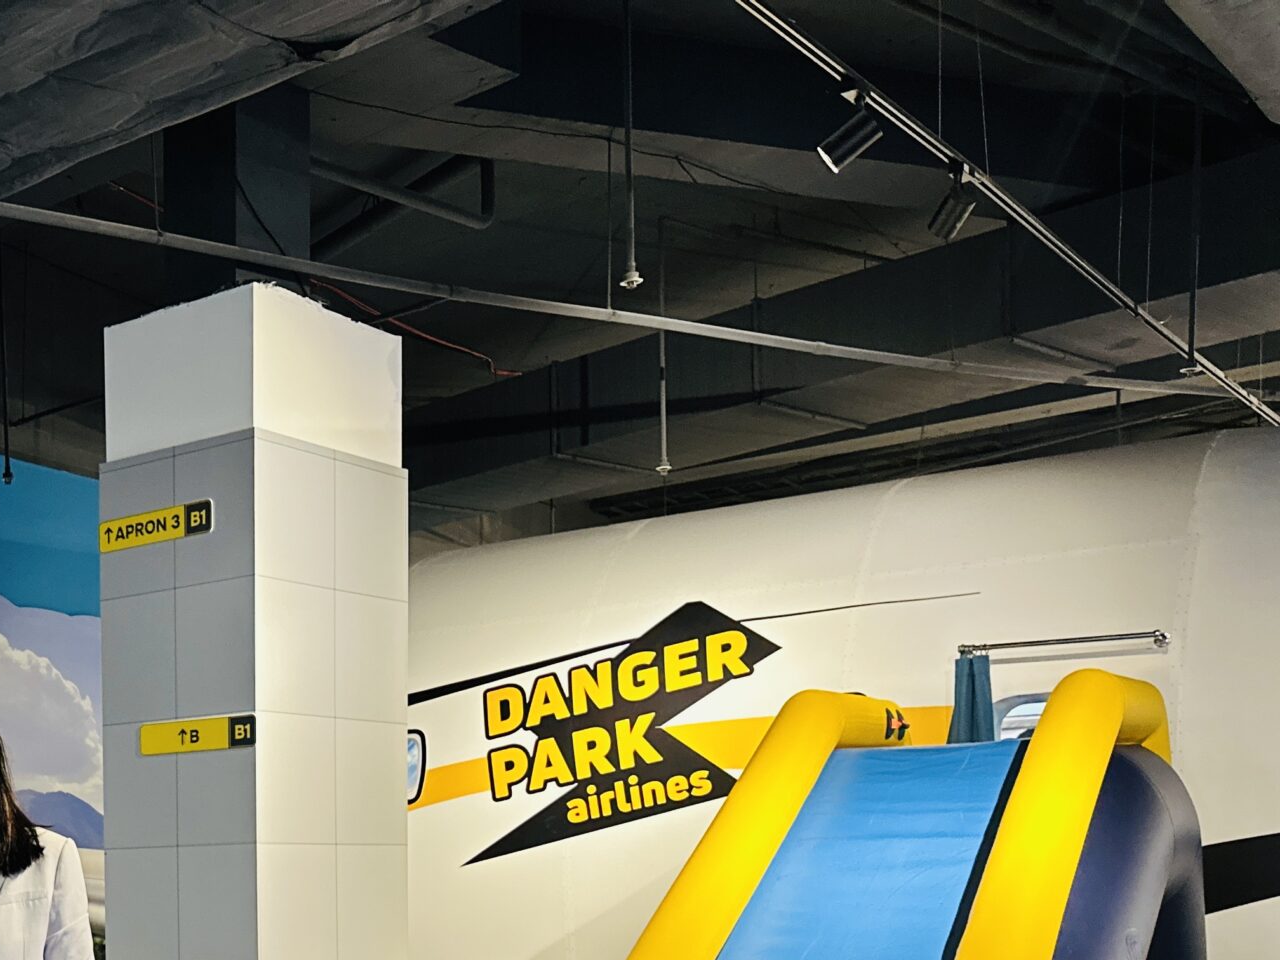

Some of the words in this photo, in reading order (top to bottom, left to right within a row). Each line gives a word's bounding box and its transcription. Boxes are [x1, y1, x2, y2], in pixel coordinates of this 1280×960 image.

[115, 517, 167, 542] APRON
[171, 514, 180, 529] 3
[190, 510, 206, 527] B1
[486, 629, 750, 737] DANGER
[189, 729, 200, 743] B
[234, 722, 251, 740] B1
[489, 711, 664, 800] PARK
[566, 769, 713, 824] airlines
